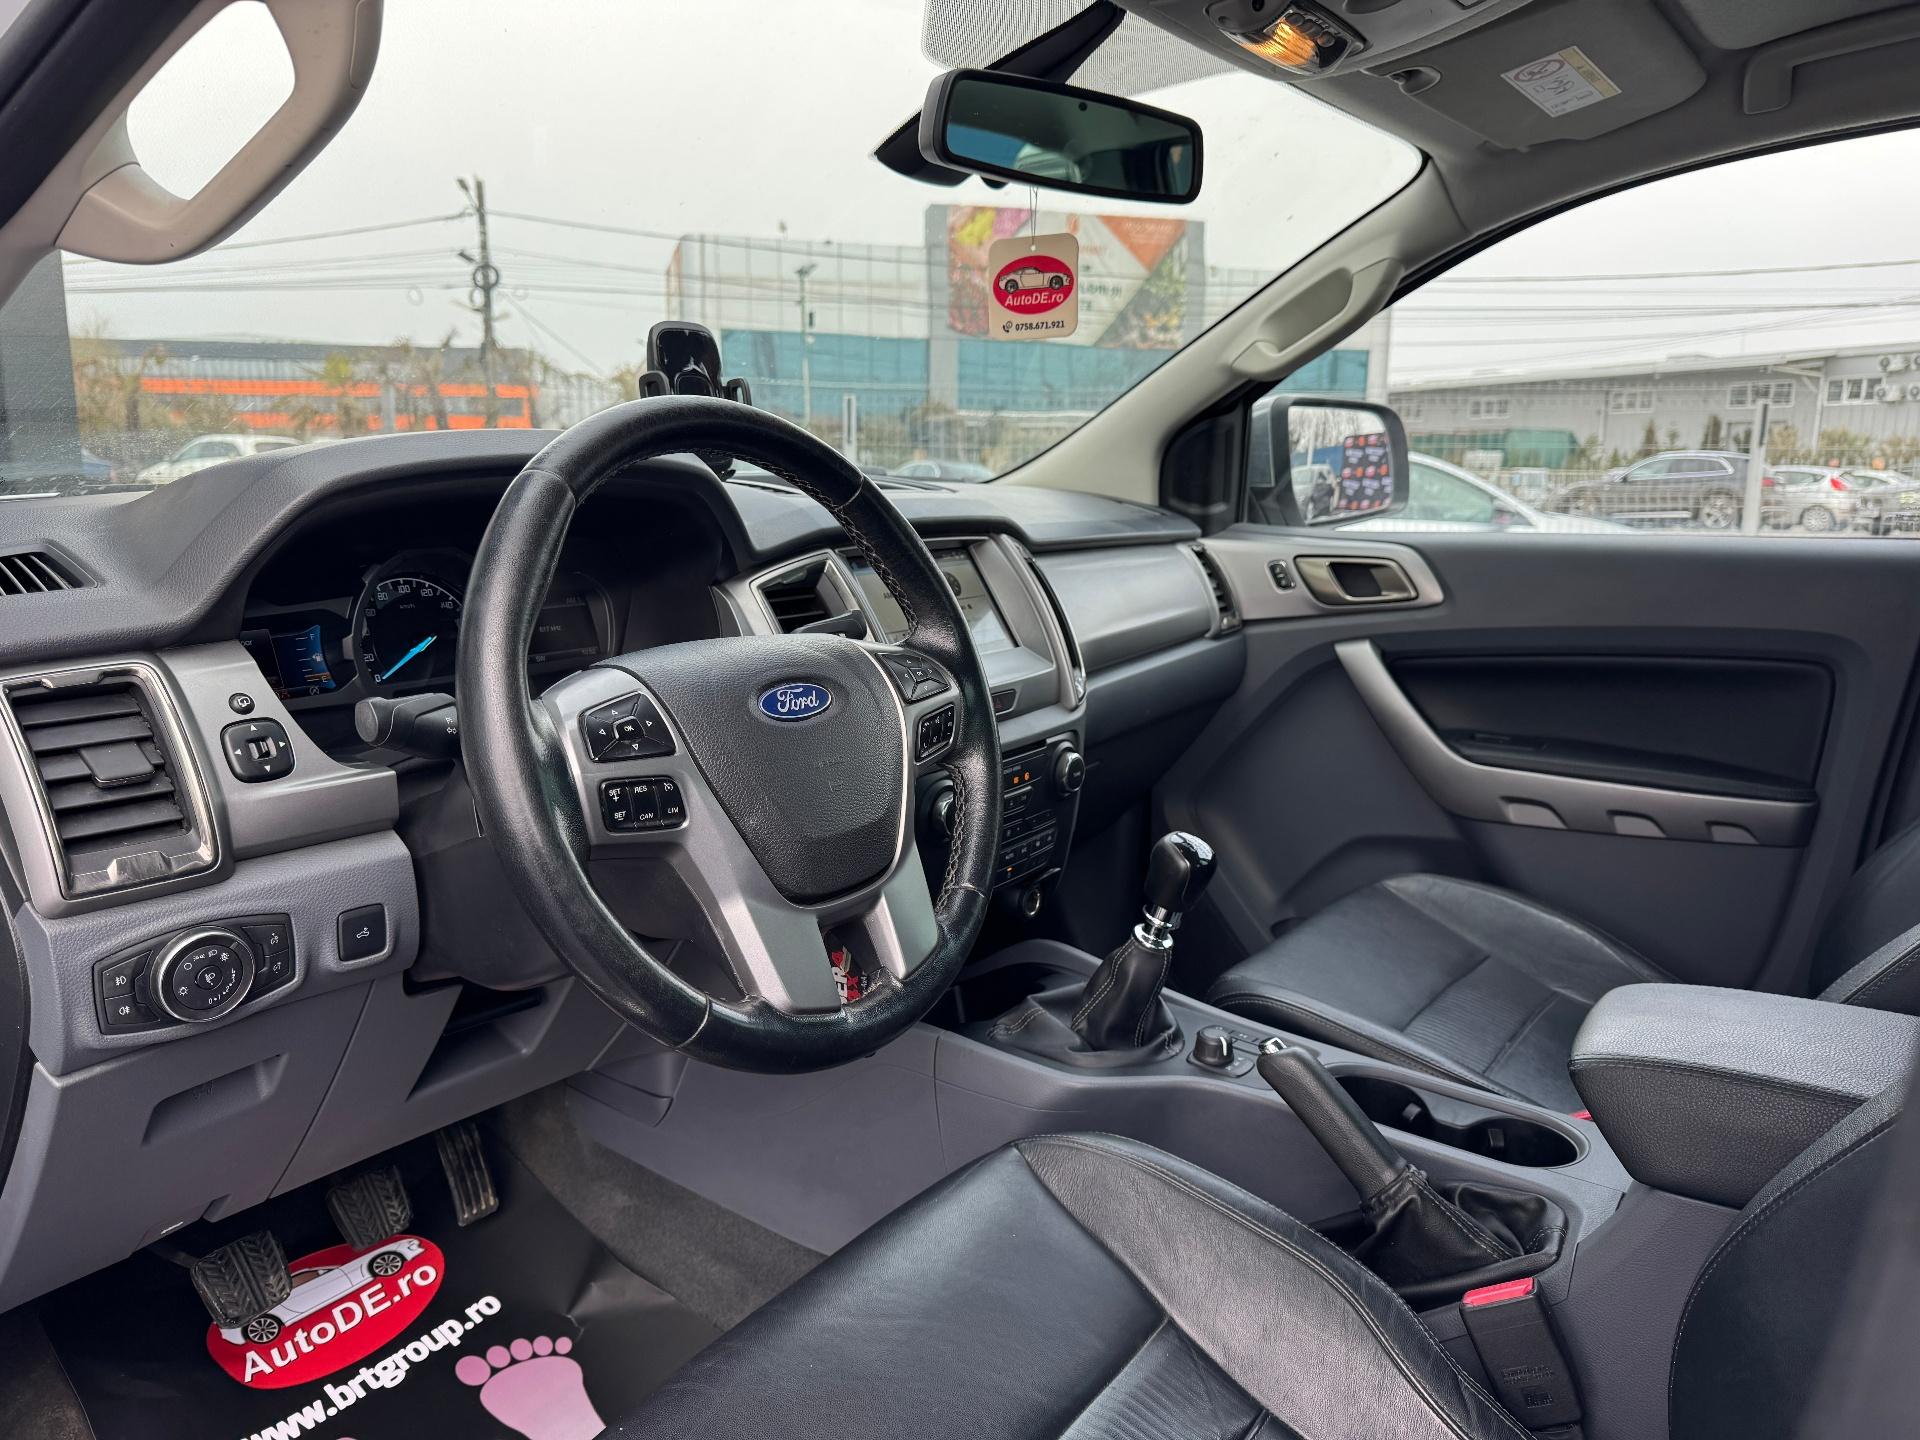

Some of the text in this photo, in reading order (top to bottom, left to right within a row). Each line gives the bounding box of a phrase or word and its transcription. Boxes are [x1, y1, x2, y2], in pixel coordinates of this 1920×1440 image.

[1004, 292, 1064, 307] AutoDE.ro
[1015, 320, 1065, 332] 0758.671.921
[397, 584, 411, 593] 100
[420, 588, 434, 597] 120
[776, 687, 820, 713] Ford
[608, 788, 621, 797] SET
[634, 785, 648, 794] RES
[614, 810, 627, 819] SET
[639, 812, 654, 821] CAN
[244, 1265, 438, 1383] AutoDE.ro
